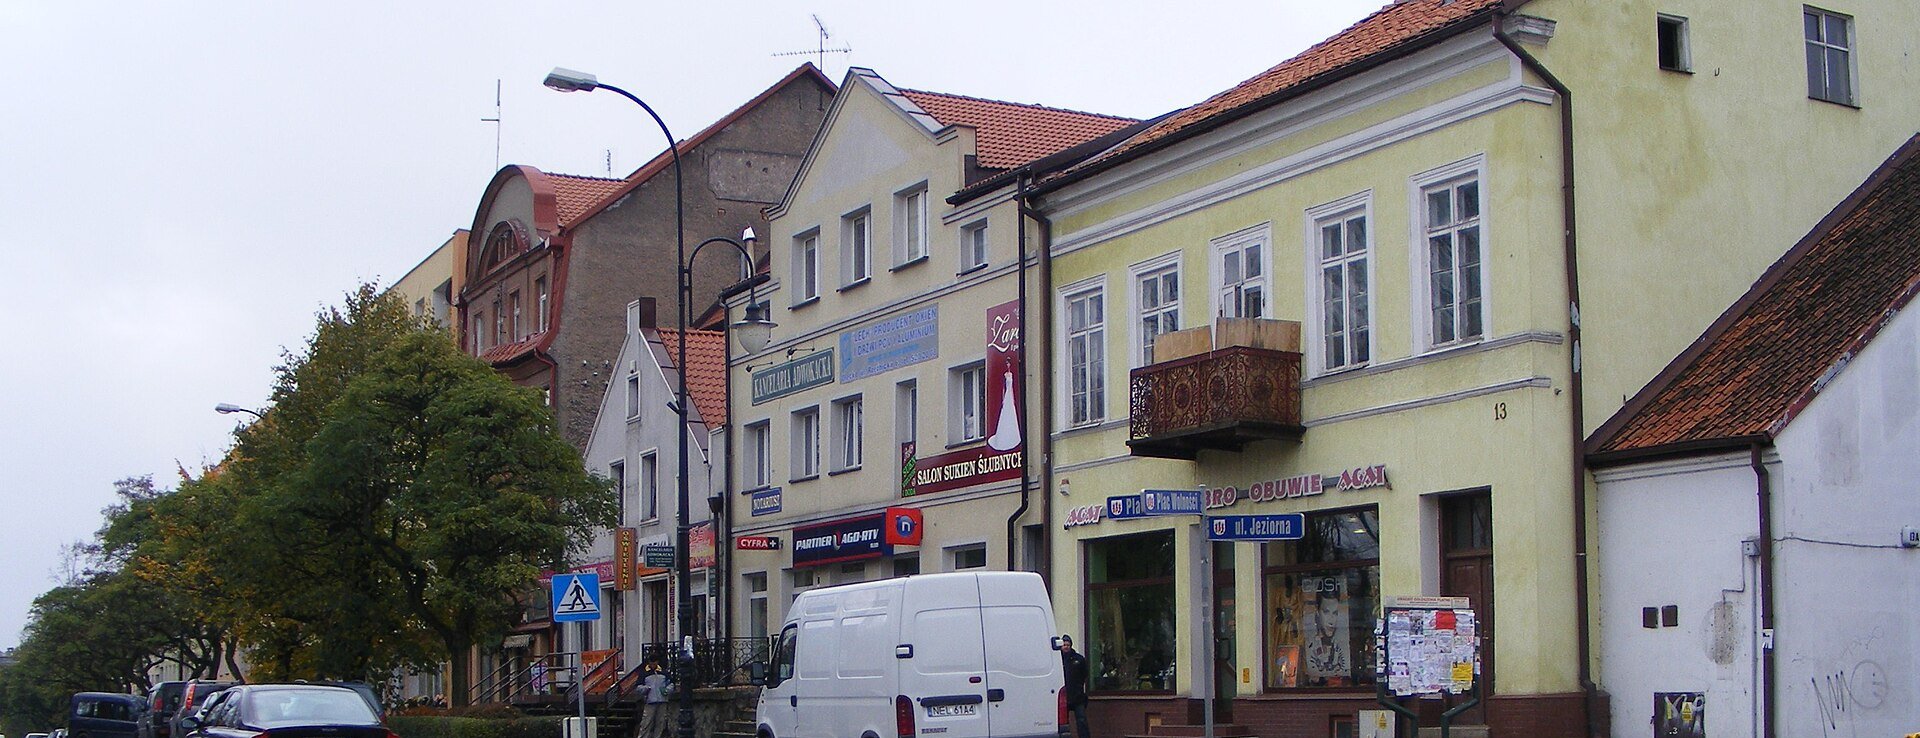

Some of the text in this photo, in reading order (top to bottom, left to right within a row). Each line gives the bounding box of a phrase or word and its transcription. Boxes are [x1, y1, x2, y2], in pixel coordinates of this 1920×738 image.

[754, 369, 791, 399] KANCELARIA
[792, 355, 832, 388] ADWOKACKA
[1494, 402, 1507, 420] 13
[917, 467, 943, 486] SALON
[943, 461, 977, 480] SUKIEN
[1249, 473, 1323, 502] OBUWIE
[1157, 493, 1198, 510] Plac Wolności
[1235, 517, 1291, 535] ul. Jeziorna
[740, 539, 768, 547] CYFRA
[795, 536, 832, 550] PARTNER
[932, 704, 974, 716] NEL 61A4
